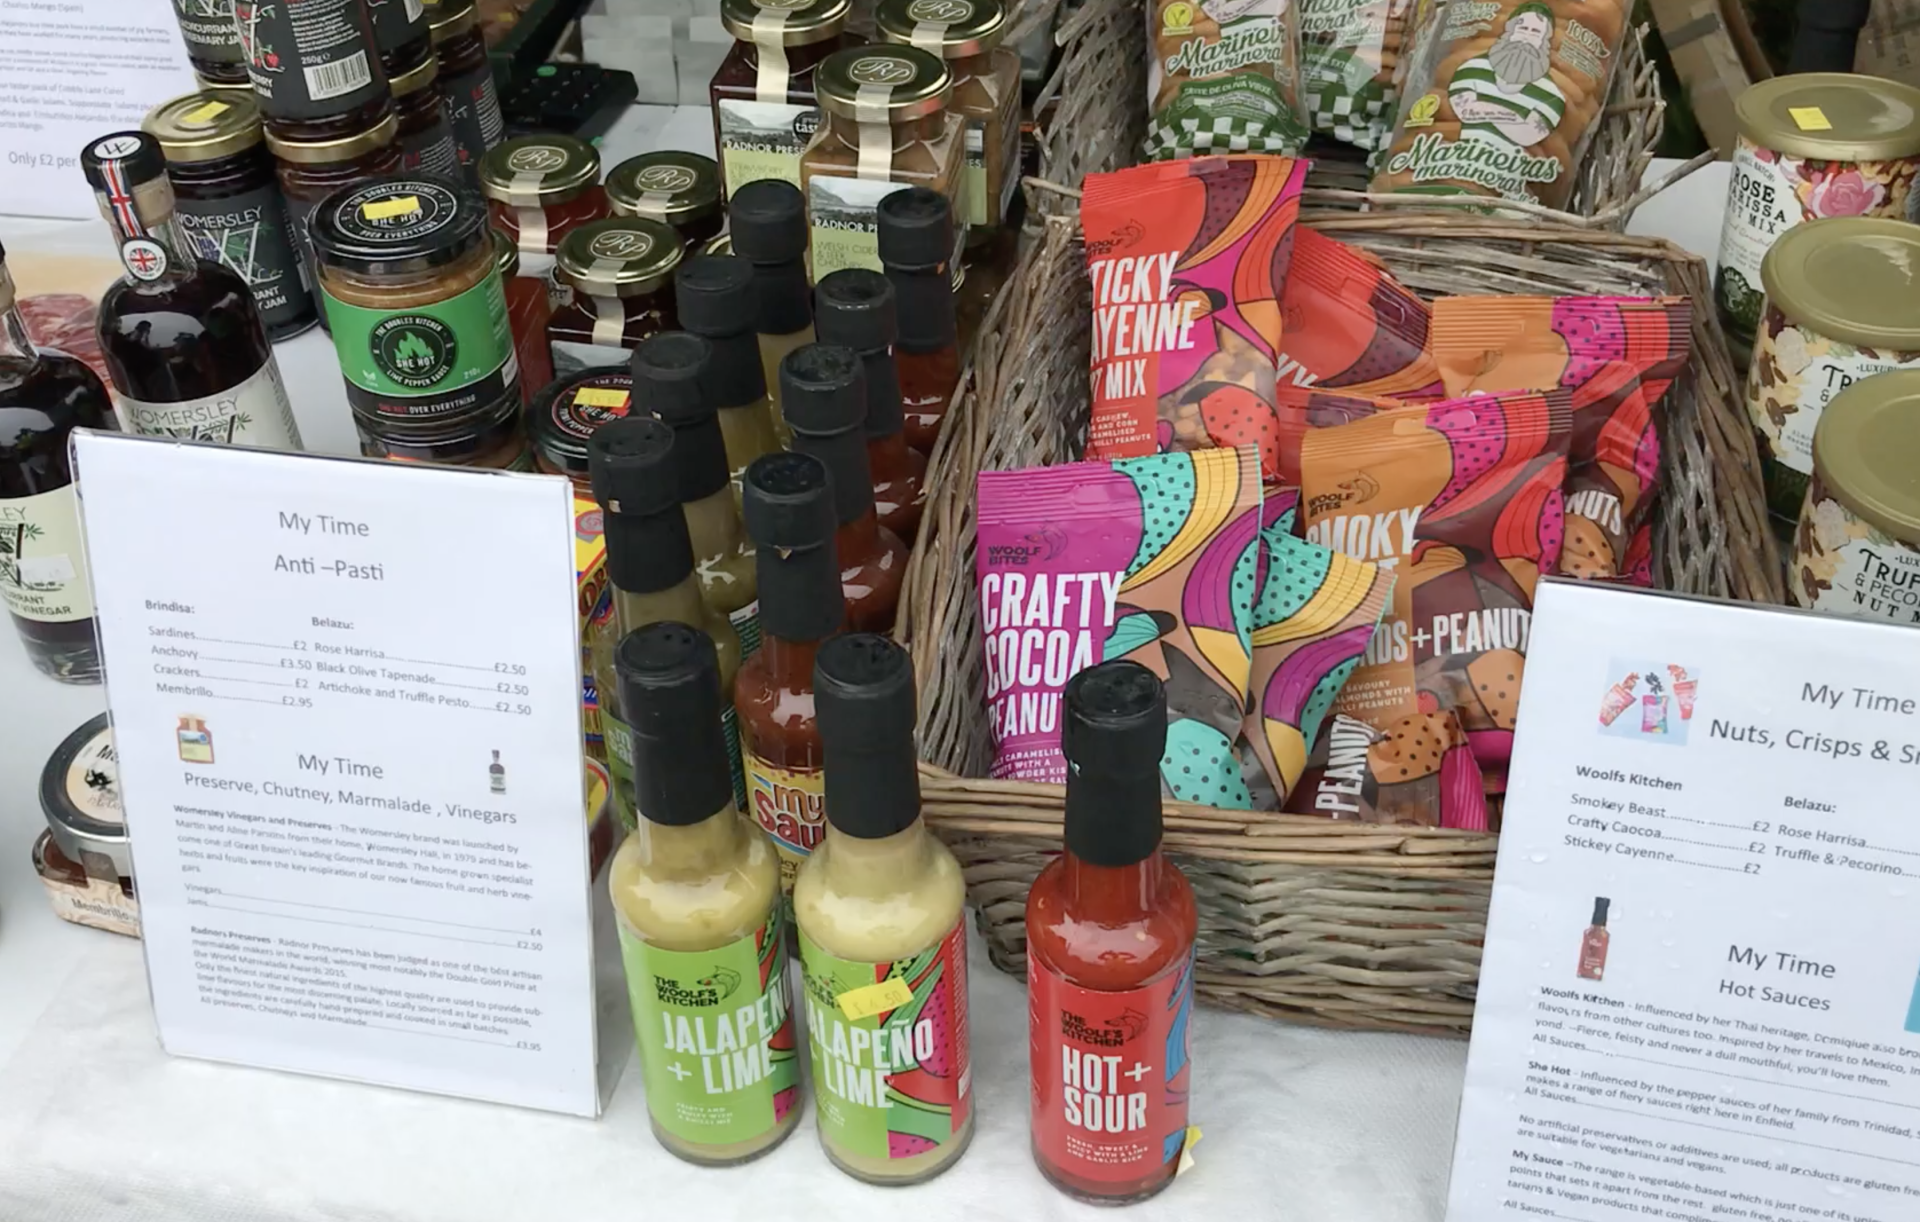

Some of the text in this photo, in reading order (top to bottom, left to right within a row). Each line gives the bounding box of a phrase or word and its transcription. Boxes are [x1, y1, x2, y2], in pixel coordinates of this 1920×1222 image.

[1165, 15, 1288, 77] Mariñeir
[1190, 49, 1283, 78] marinera
[8, 151, 76, 167] Only £2 per
[726, 140, 772, 152] RADNOR
[1387, 131, 1560, 182] Mariñeiras
[1412, 159, 1526, 196] marineras
[1734, 166, 1775, 204] ROSE
[1728, 179, 1787, 223] ARISSA
[175, 206, 262, 230] WOMERSLEY
[384, 220, 440, 239] EVERYTHING
[815, 218, 864, 232] RADNOR
[1748, 213, 1777, 235] MIX
[1091, 251, 1180, 310] TICKY
[415, 317, 444, 333] KITCHEN
[1091, 300, 1200, 366] AYENNE
[395, 356, 436, 368] SHE HOT
[403, 378, 431, 387] PEPPER
[1105, 359, 1148, 400] MIX
[130, 396, 239, 427] WOMERSLEY
[409, 394, 476, 414] OVER EVERYTHING
[578, 404, 597, 416] SHE
[574, 418, 594, 436] PEPPER
[1116, 419, 1138, 428] CORN
[1308, 490, 1356, 508] WOOLF
[279, 511, 371, 537] My Time
[1306, 504, 1426, 559] SMOKY
[988, 545, 1042, 557] WOOLF
[988, 555, 1029, 566] BITES
[274, 554, 316, 575] Anti
[1859, 548, 1920, 590] TRUF
[1855, 573, 1865, 587] &
[145, 599, 196, 615] Brindisa:
[981, 571, 1127, 636] CRAFTY
[1853, 589, 1899, 618] NUT
[311, 616, 354, 630] Belazu:
[151, 645, 312, 671] Anchovy £3.50
[293, 641, 307, 652] £2
[314, 642, 526, 676] Rose Harrisa £2.50
[153, 664, 309, 689] Crackers £2
[985, 629, 1094, 700] COCOA
[316, 661, 529, 696] Black Olive Tapenade £2.50
[1387, 685, 1411, 698] WITH
[156, 683, 313, 709] Membrillo £2.95
[318, 681, 469, 709] Artichoke and Truffle Pesto
[1356, 696, 1405, 710] PEANUTS
[1800, 681, 1916, 716] My Time
[988, 692, 1063, 744] PEANU
[1709, 718, 1777, 749] Nuts,
[1785, 729, 1863, 760] Crisps
[1870, 739, 1892, 762] &
[298, 754, 384, 779] My Time
[1014, 760, 1042, 769] WITH
[1575, 765, 1683, 792] Woolfs Kitchen
[184, 772, 517, 825] Preserve, Chutney, Marmalade Vinegars
[1783, 795, 1837, 814] Belazu:
[753, 788, 826, 851] sau
[1570, 793, 1771, 834] Smokey Beast £2
[268, 816, 519, 854] and Preserves The brand launched by
[1567, 813, 1766, 855] Crafty Caocoa £2
[1778, 824, 1867, 849] Rose Harrisa
[479, 856, 496, 866] and
[1564, 833, 1762, 876] Stickey Cayenne £2
[1774, 845, 1903, 877] Truffle & Pecorino
[71, 898, 130, 920] Membrillo
[191, 925, 271, 944] Radnors Preserves
[1728, 944, 1837, 979] My Time
[653, 975, 680, 989] THE
[1719, 979, 1831, 1011] Hot Sauces
[658, 993, 719, 1007] KITCHEN
[1541, 986, 1732, 1028] Woolfs Influenced by her
[1061, 1009, 1087, 1026] THE
[806, 998, 934, 1068] ALAPEÑO
[1062, 1028, 1124, 1047] KITCHEN
[1613, 1013, 1859, 1065] other cultures by to
[667, 1034, 777, 1094] + LIME
[1739, 1053, 1794, 1072] mouthful,
[823, 1048, 894, 1108] LIME
[1528, 1060, 1791, 1115] She Hot Influenced the her
[1064, 1086, 1147, 1133] SOUR
[1519, 1114, 1653, 1147] No preservatives
[1581, 1138, 1597, 1149] for
[1094, 1150, 1117, 1158] WITH
[1512, 1149, 1564, 1168] My Sauce
[1503, 1198, 1517, 1210] All
